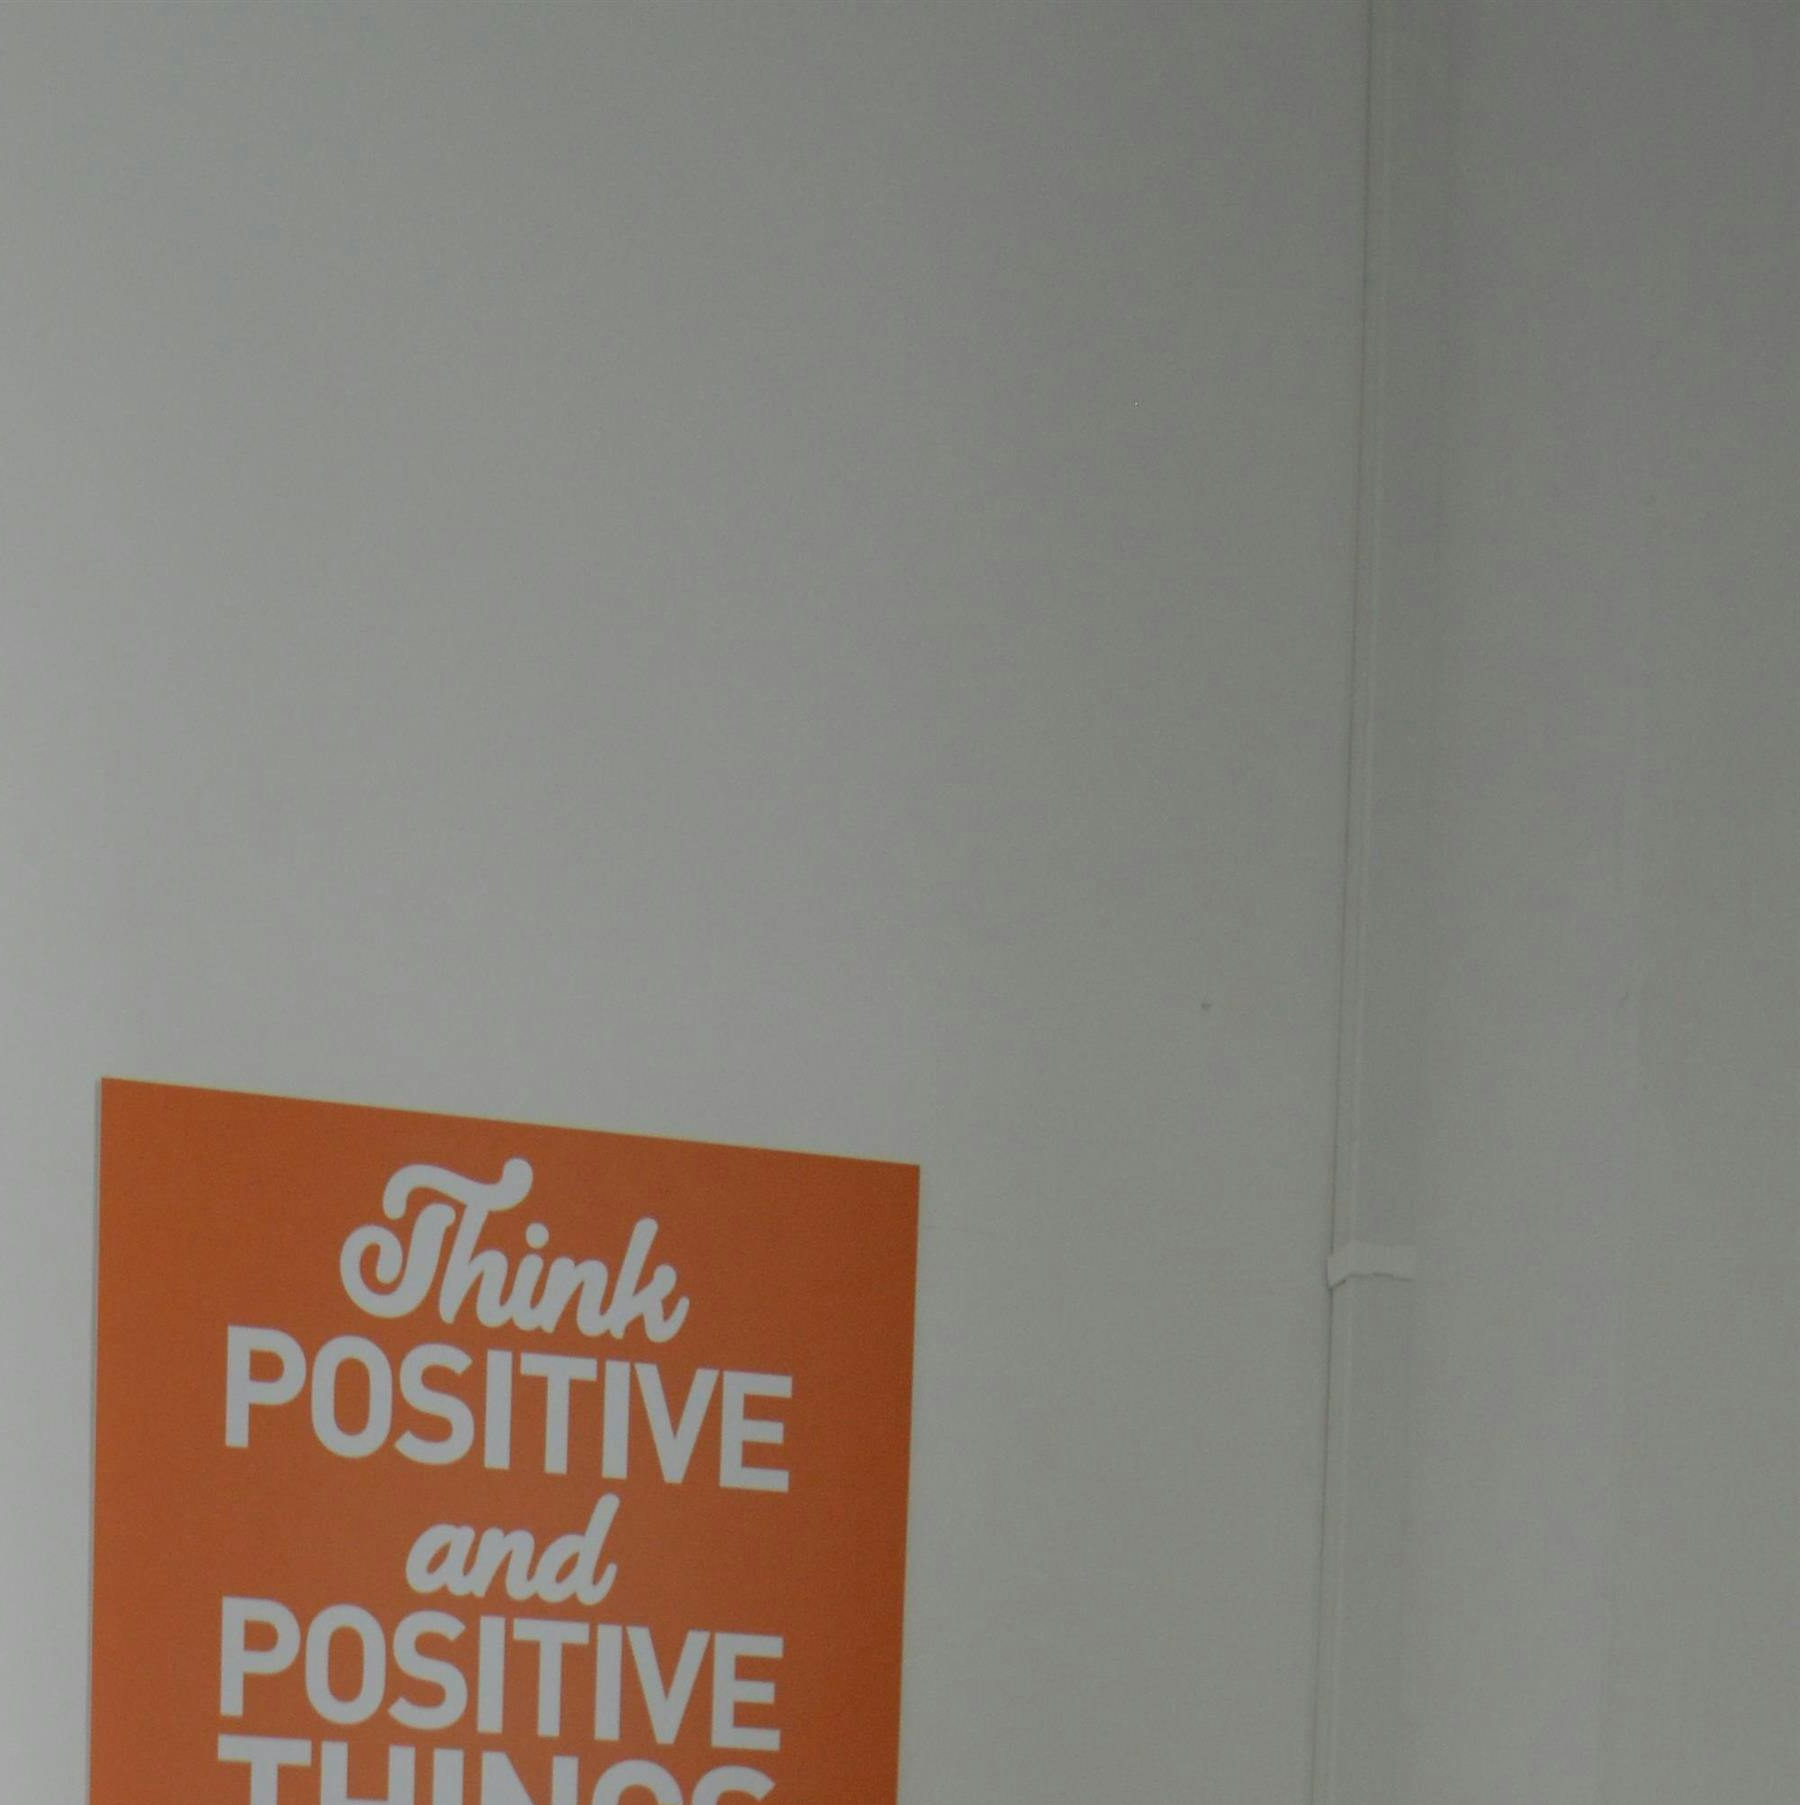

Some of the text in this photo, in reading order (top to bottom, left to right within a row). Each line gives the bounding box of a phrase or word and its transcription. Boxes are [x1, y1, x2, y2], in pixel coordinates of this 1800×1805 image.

[339, 1157, 690, 1342] Think
[225, 1325, 792, 1491] POSITIVE
[405, 1493, 620, 1605] and
[220, 1596, 783, 1750] POSITIVE
